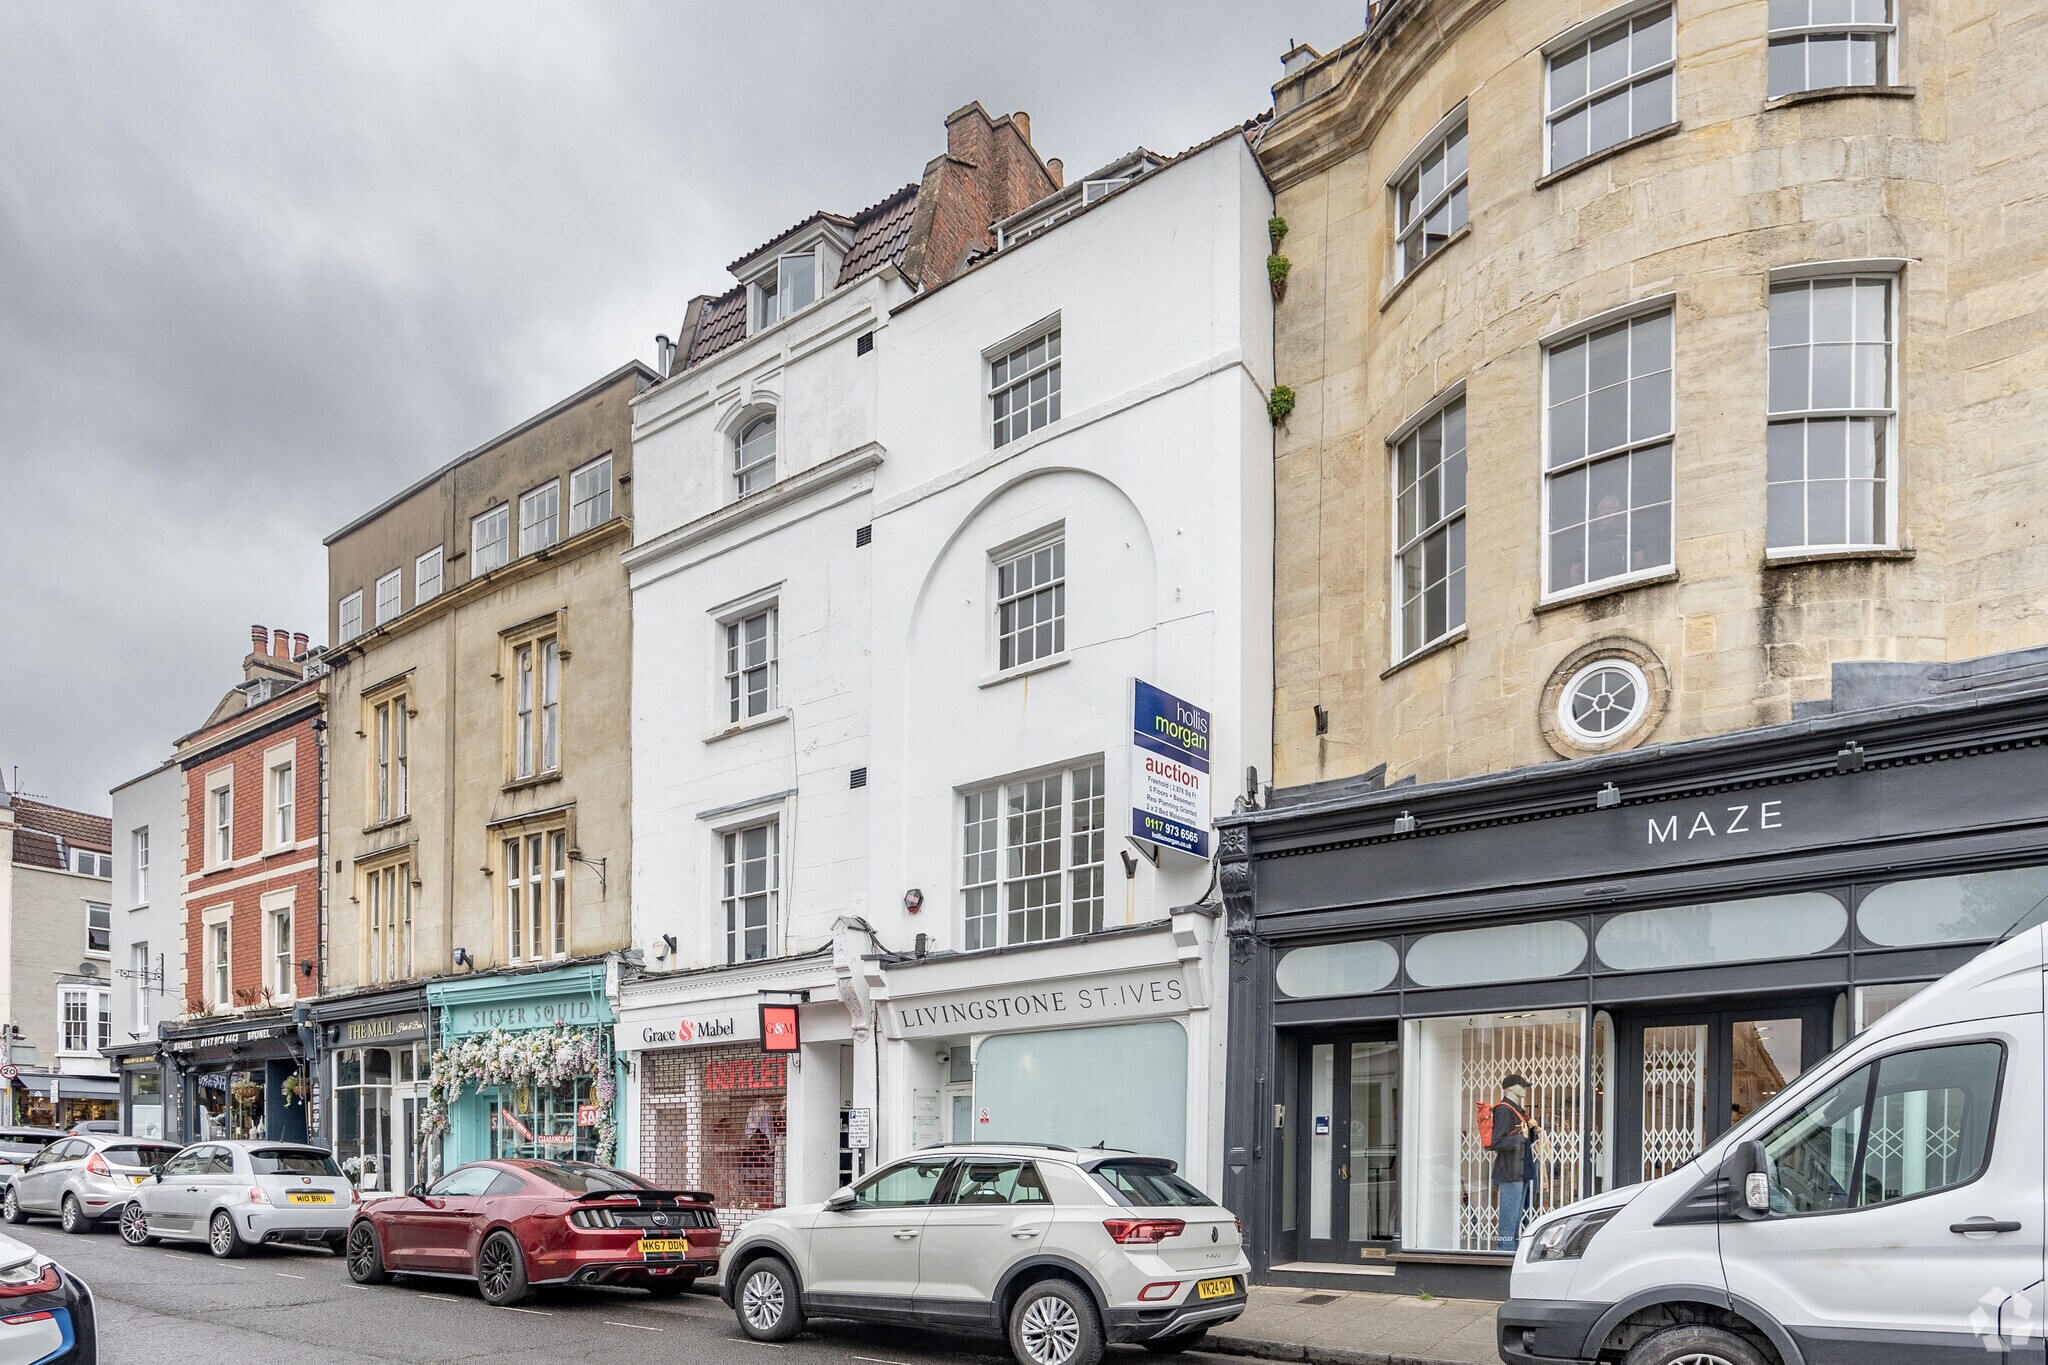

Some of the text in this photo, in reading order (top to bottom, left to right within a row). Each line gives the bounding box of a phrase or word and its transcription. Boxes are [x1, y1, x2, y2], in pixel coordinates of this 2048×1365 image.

[1177, 702, 1208, 733] hollis
[1156, 716, 1206, 751] morgan
[1146, 758, 1198, 790] auction
[1148, 776, 1169, 788] Freehold
[1147, 794, 1197, 817] Resi Planning Granted
[1153, 786, 1168, 798] Floors
[1173, 794, 1195, 808] Basement
[1159, 808, 1168, 816] Bed
[1648, 800, 1782, 844] MAZE
[1145, 817, 1198, 843] 0117 973 6565
[1152, 832, 1192, 849] hollismorgan.co.uk
[472, 1002, 590, 1028] SILVER SQUID
[900, 992, 1066, 1028] LIVINGSTONE
[174, 1041, 193, 1051] BRUNEL
[247, 1029, 270, 1040] BRUNEL
[348, 1023, 366, 1040] THE
[367, 1021, 394, 1038] MALL
[643, 1018, 734, 1042] Grace & Mabel
[706, 1058, 786, 1090] OUTLET
[643, 1241, 685, 1250] MK67 DDN
